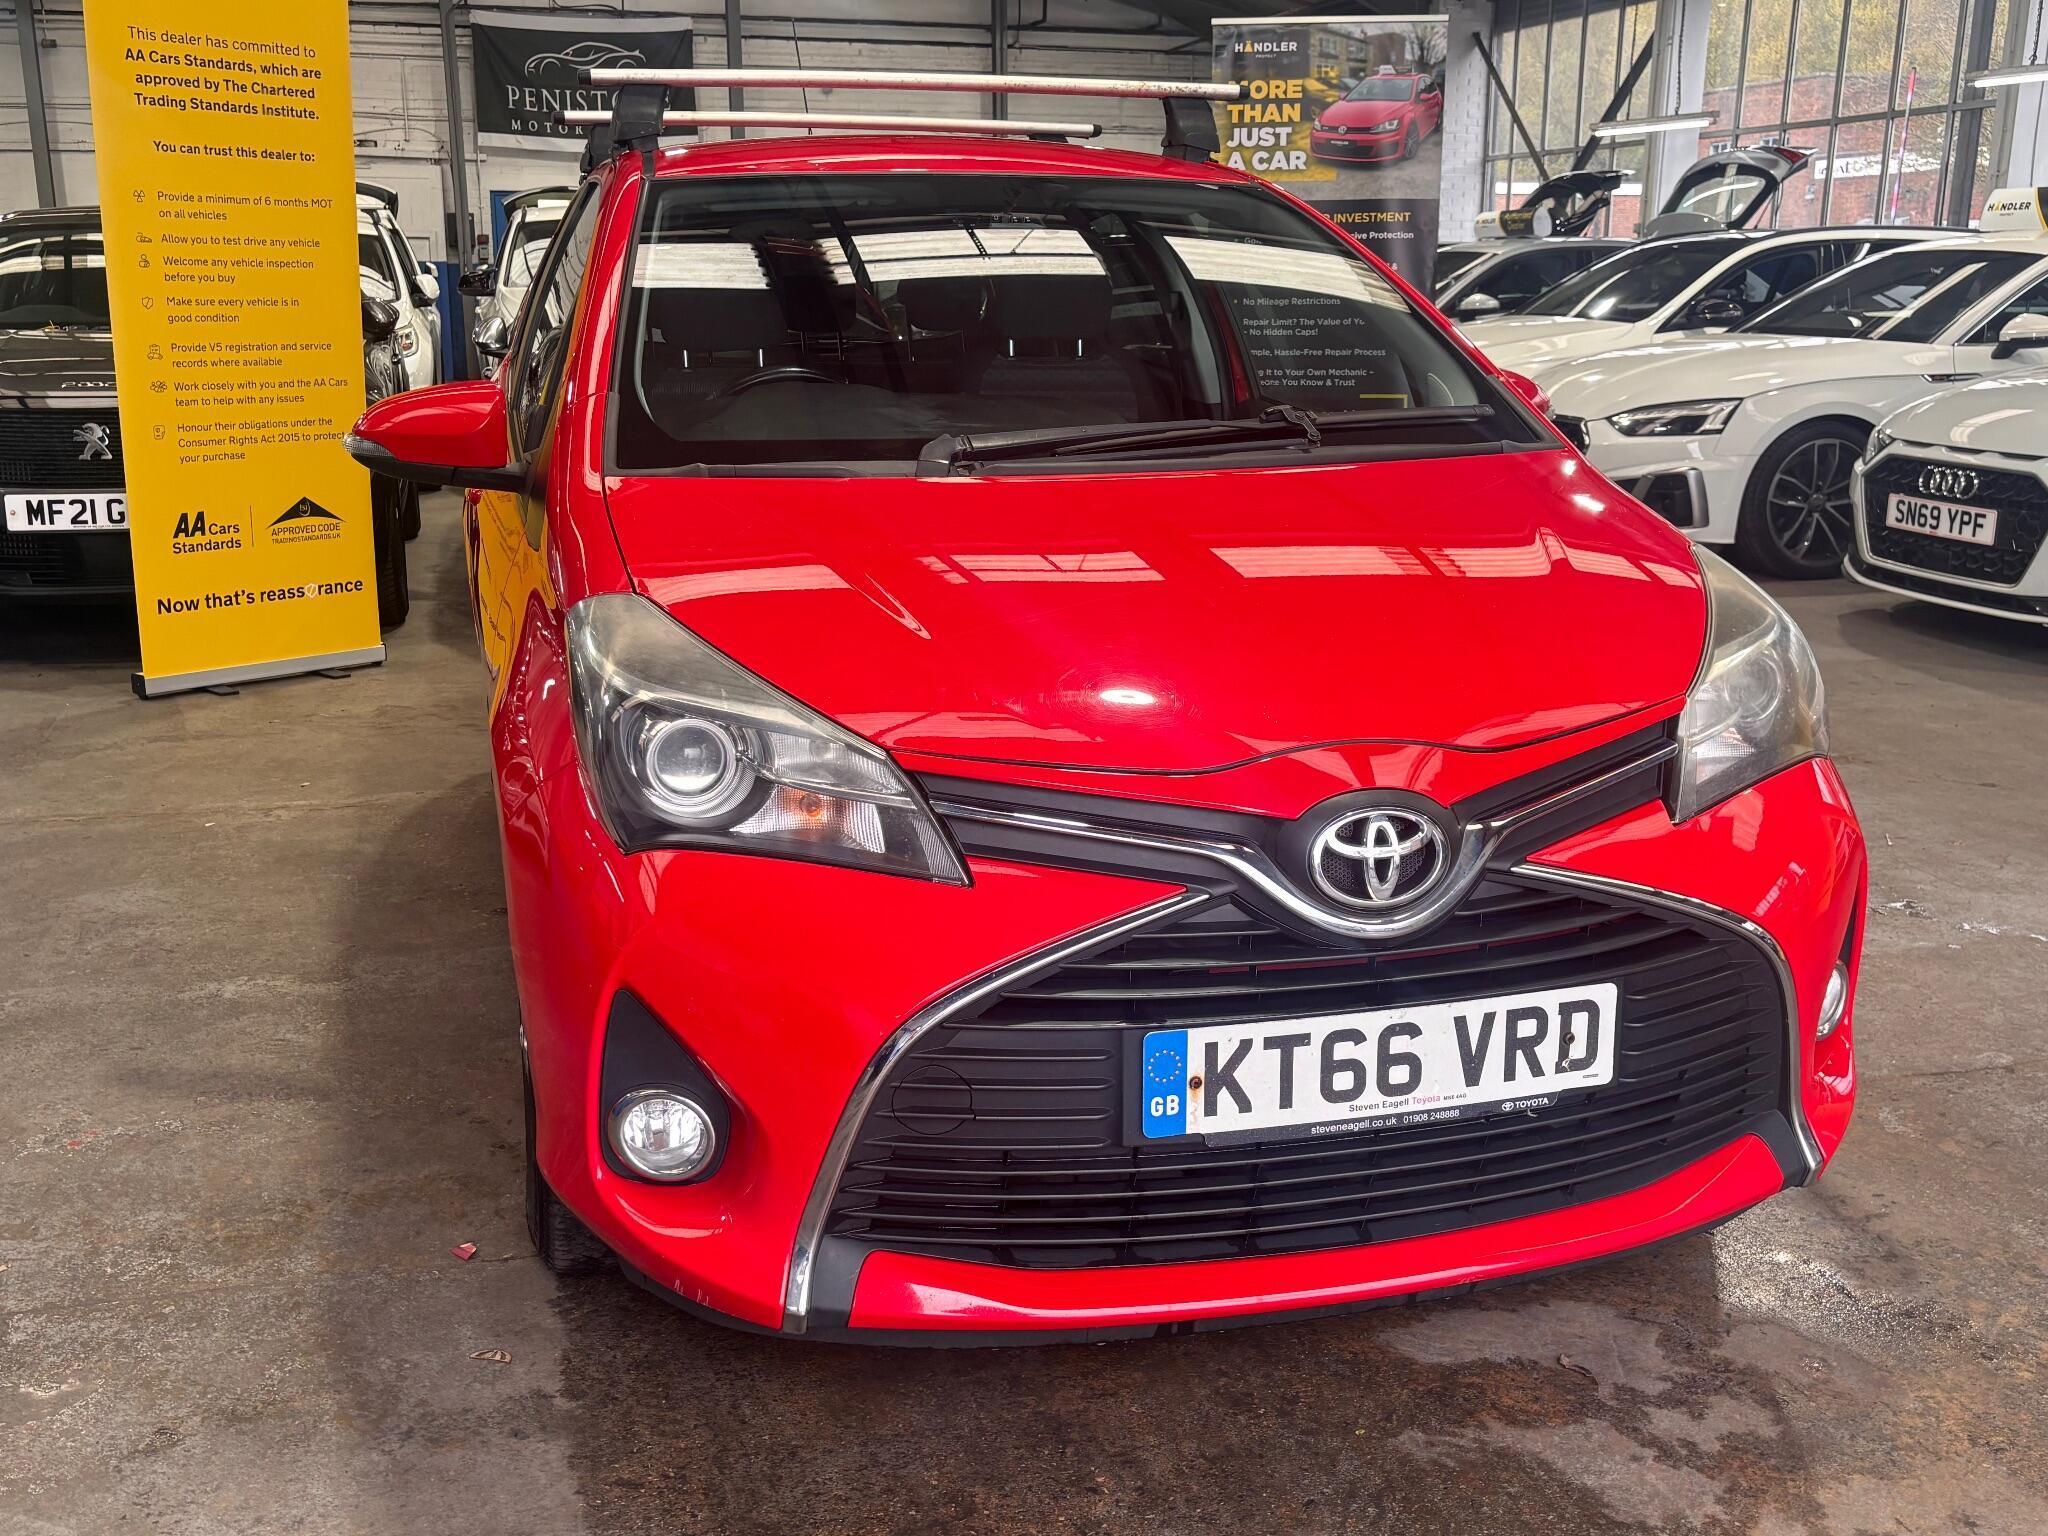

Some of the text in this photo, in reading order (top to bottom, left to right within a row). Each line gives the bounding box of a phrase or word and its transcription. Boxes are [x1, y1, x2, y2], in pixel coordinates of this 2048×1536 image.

[128, 26, 316, 58] This dealer has committed to
[125, 48, 321, 80] AA Cars Standards, which are
[136, 72, 315, 99] approved by The Chartered
[1228, 79, 1303, 99] ORE
[134, 93, 319, 120] Trading Standards Institute.
[1227, 103, 1301, 123] THAN
[1226, 127, 1292, 148] JUST
[153, 140, 315, 162] You can trust this dealer to:
[1226, 152, 1307, 170] A CAR
[158, 192, 332, 208] Provide a minimum of 6 months MOT
[159, 209, 227, 220] on all vehicles
[1334, 212, 1411, 223] INVESTMENT
[161, 234, 320, 249] Allow you to test drive any vehicle
[163, 256, 314, 271] Welcome any vehicle inspection
[164, 272, 235, 285] before you buy
[166, 296, 299, 309] Make sure every vehicle is in
[1257, 298, 1289, 307] Mileage
[1291, 297, 1340, 305] Restrictions
[168, 312, 239, 324] good condition
[1243, 318, 1269, 327] Repair
[1271, 318, 1297, 326] Limit?
[1295, 328, 1318, 337] Caps!
[171, 341, 332, 354] Provide V5 registration and service
[1274, 349, 1323, 357] Hassle-Free
[1325, 349, 1351, 357] Repair
[172, 356, 282, 368] records where available
[1328, 368, 1367, 376] Mechanic
[174, 377, 348, 392] Work closely with you and the AA Cars
[175, 394, 305, 408] team to help with any issues
[178, 417, 332, 433] Honour their obligations under the
[178, 431, 345, 448] Consumer Rights Act 2015 to protect
[180, 451, 246, 464] your purchase
[26, 499, 97, 525] MF21
[1895, 499, 1986, 537] SN69 YPF
[173, 511, 240, 538] AA Cars
[272, 523, 340, 536] APPROVED CODE
[172, 538, 242, 554] Standards
[157, 598, 200, 615] Now
[1203, 999, 1601, 1117] KT66 VRD
[1150, 1095, 1180, 1117] GB
[1349, 1102, 1380, 1113] Steven
[1382, 1098, 1409, 1109] Eagell
[1412, 1094, 1441, 1106] Toyota
[1515, 1097, 1548, 1108] TOYOTA
[1311, 1109, 1460, 1135] steveneagell.co.uk 01908 248888
